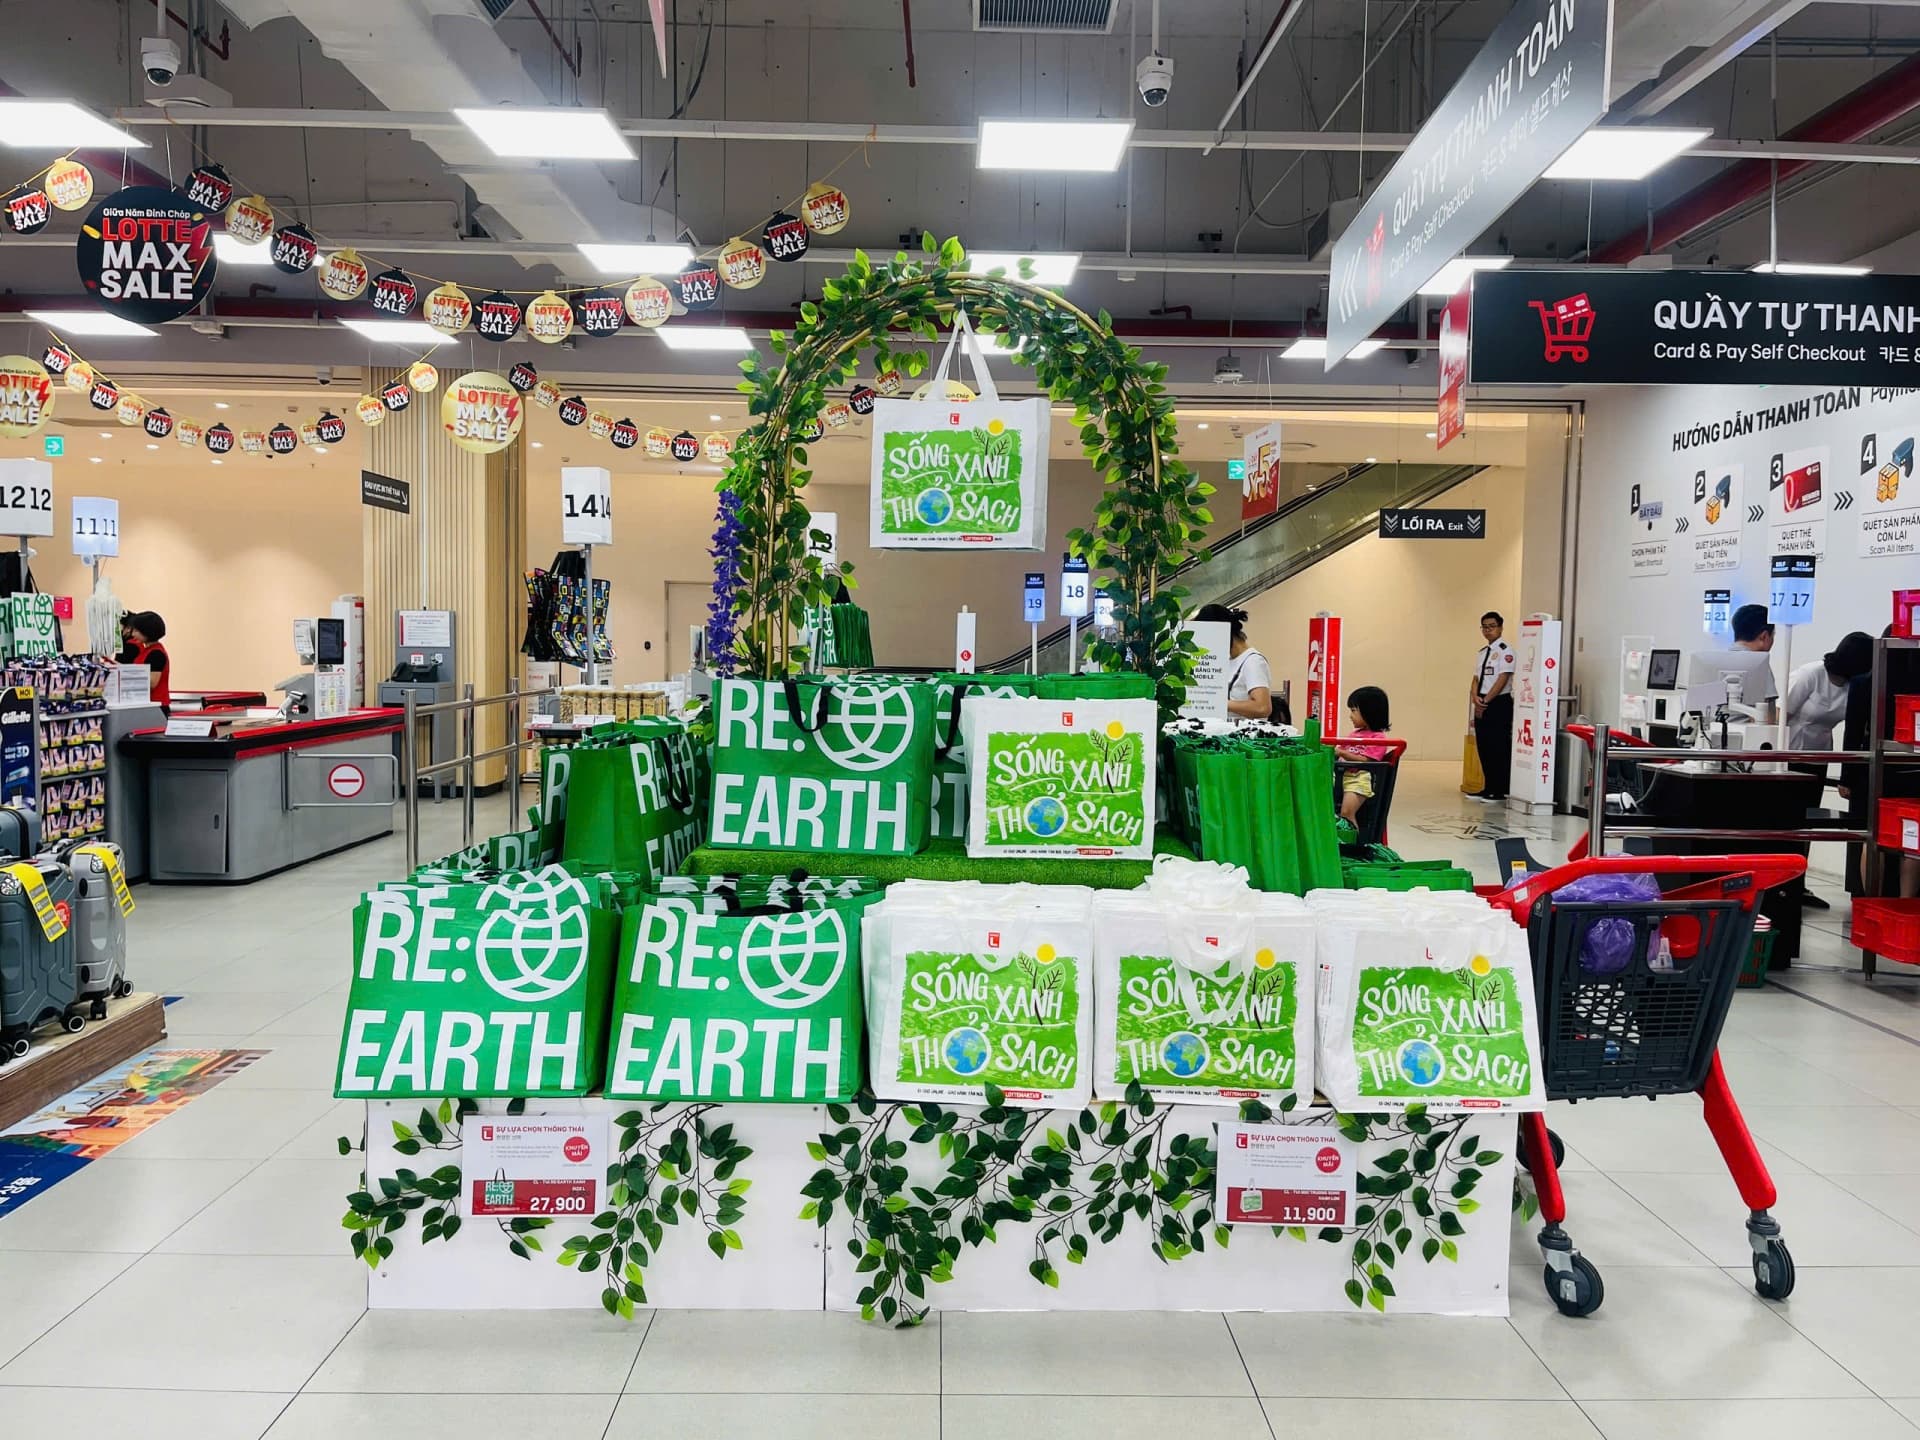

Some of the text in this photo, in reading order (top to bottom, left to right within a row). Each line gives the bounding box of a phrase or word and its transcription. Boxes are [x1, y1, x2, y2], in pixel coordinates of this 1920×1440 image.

[1454, 57, 1513, 166] THANH
[188, 190, 220, 211] SALE
[192, 180, 224, 201] MAX
[12, 203, 43, 220] MAX
[125, 208, 145, 217] Năm
[811, 202, 842, 220] MAX
[813, 211, 845, 230] SALE
[1411, 232, 1423, 255] Pay
[1424, 209, 1438, 244] Self
[1438, 175, 1475, 228] Checkout
[14, 213, 47, 230] SALE
[102, 218, 192, 242] LOTTE
[233, 213, 264, 233] MAX
[229, 222, 261, 242] SALE
[771, 229, 803, 249] MAX
[102, 241, 192, 270] MAX
[277, 240, 308, 260] MAX
[774, 240, 806, 258] SALE
[273, 250, 306, 270] SALE
[727, 258, 759, 275] MAX
[100, 270, 193, 300] SALE
[328, 268, 359, 285] MAX
[729, 267, 761, 284] SALE
[324, 277, 357, 296] SALE
[376, 287, 408, 304] MAX
[682, 279, 712, 294] MAX
[373, 297, 407, 314] SALE
[683, 290, 715, 305] SALE
[430, 314, 463, 329] SALE
[431, 306, 464, 318] MAX
[481, 312, 513, 325] MAX
[534, 313, 565, 325] MAX
[586, 308, 617, 320] MAX
[1654, 292, 1920, 338] QUẦY TỰ THANH
[480, 322, 513, 335] SALE
[532, 323, 566, 336] SALE
[586, 318, 619, 331] SALE
[1654, 342, 1910, 365] Card & Pay Self Checkout 카드
[458, 389, 509, 408] LOTTE
[457, 404, 508, 424] MAX
[455, 419, 507, 441] SALE
[1672, 421, 1720, 452] HƯỚNG
[1723, 411, 1754, 440] DẪN
[1756, 400, 1810, 432] THANH
[889, 433, 1009, 483] SỐNG XANH
[1863, 441, 1874, 464] 4
[1772, 459, 1782, 483] 3
[1696, 476, 1704, 496] 2
[30, 487, 52, 511] 12
[565, 494, 599, 518] 14
[1632, 489, 1639, 507] 1
[956, 491, 1019, 529] SẠCH
[76, 517, 117, 537] 11 11
[1402, 516, 1463, 531] LỐI RA Exit
[1870, 546, 1885, 554] Scan
[1896, 544, 1914, 552] Items
[1066, 585, 1085, 598] 18
[1772, 593, 1810, 607] 17 17
[1028, 598, 1042, 608] 19
[1714, 612, 1726, 621] 21
[1544, 675, 1553, 729] LOTTE
[993, 736, 1132, 792] SỐNG XANH
[1541, 736, 1552, 784] MART
[711, 773, 907, 852] EARTH
[1072, 800, 1142, 841] SẠCH
[359, 902, 471, 983] RE:
[630, 903, 733, 991] RE:
[911, 957, 1063, 1022] SỐNG XANH
[1362, 971, 1430, 1026] SỐNG
[1436, 996, 1505, 1033] XANH
[341, 1009, 582, 1091] EARTH
[611, 1012, 842, 1100] EARTH
[995, 1034, 1075, 1083] SẠCH
[1214, 1038, 1293, 1084] SẠCH
[1451, 1044, 1528, 1090] SẠCH
[543, 1125, 567, 1133] THÔNG
[485, 1194, 513, 1205] EARTH
[530, 1197, 585, 1214] 27,900
[1283, 1207, 1336, 1222] 11,900
